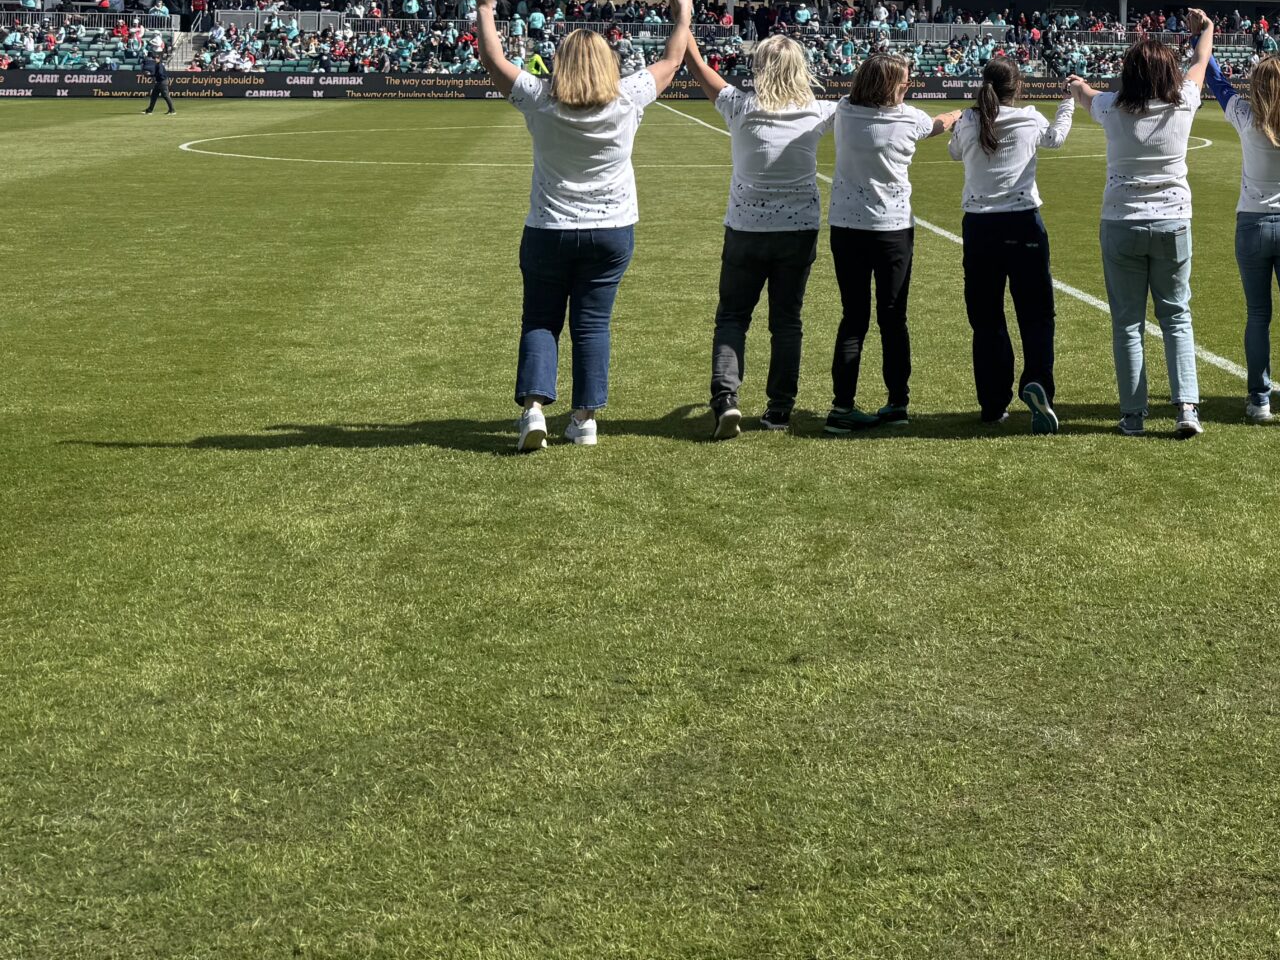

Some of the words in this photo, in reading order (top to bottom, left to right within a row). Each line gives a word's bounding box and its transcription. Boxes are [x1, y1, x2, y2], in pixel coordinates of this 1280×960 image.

[175, 76, 191, 84] car
[192, 76, 221, 87] buying
[223, 76, 251, 85] should
[253, 76, 264, 85] be
[385, 76, 400, 85] The
[402, 78, 419, 87] way
[436, 77, 463, 88] buying
[465, 78, 491, 86] should
